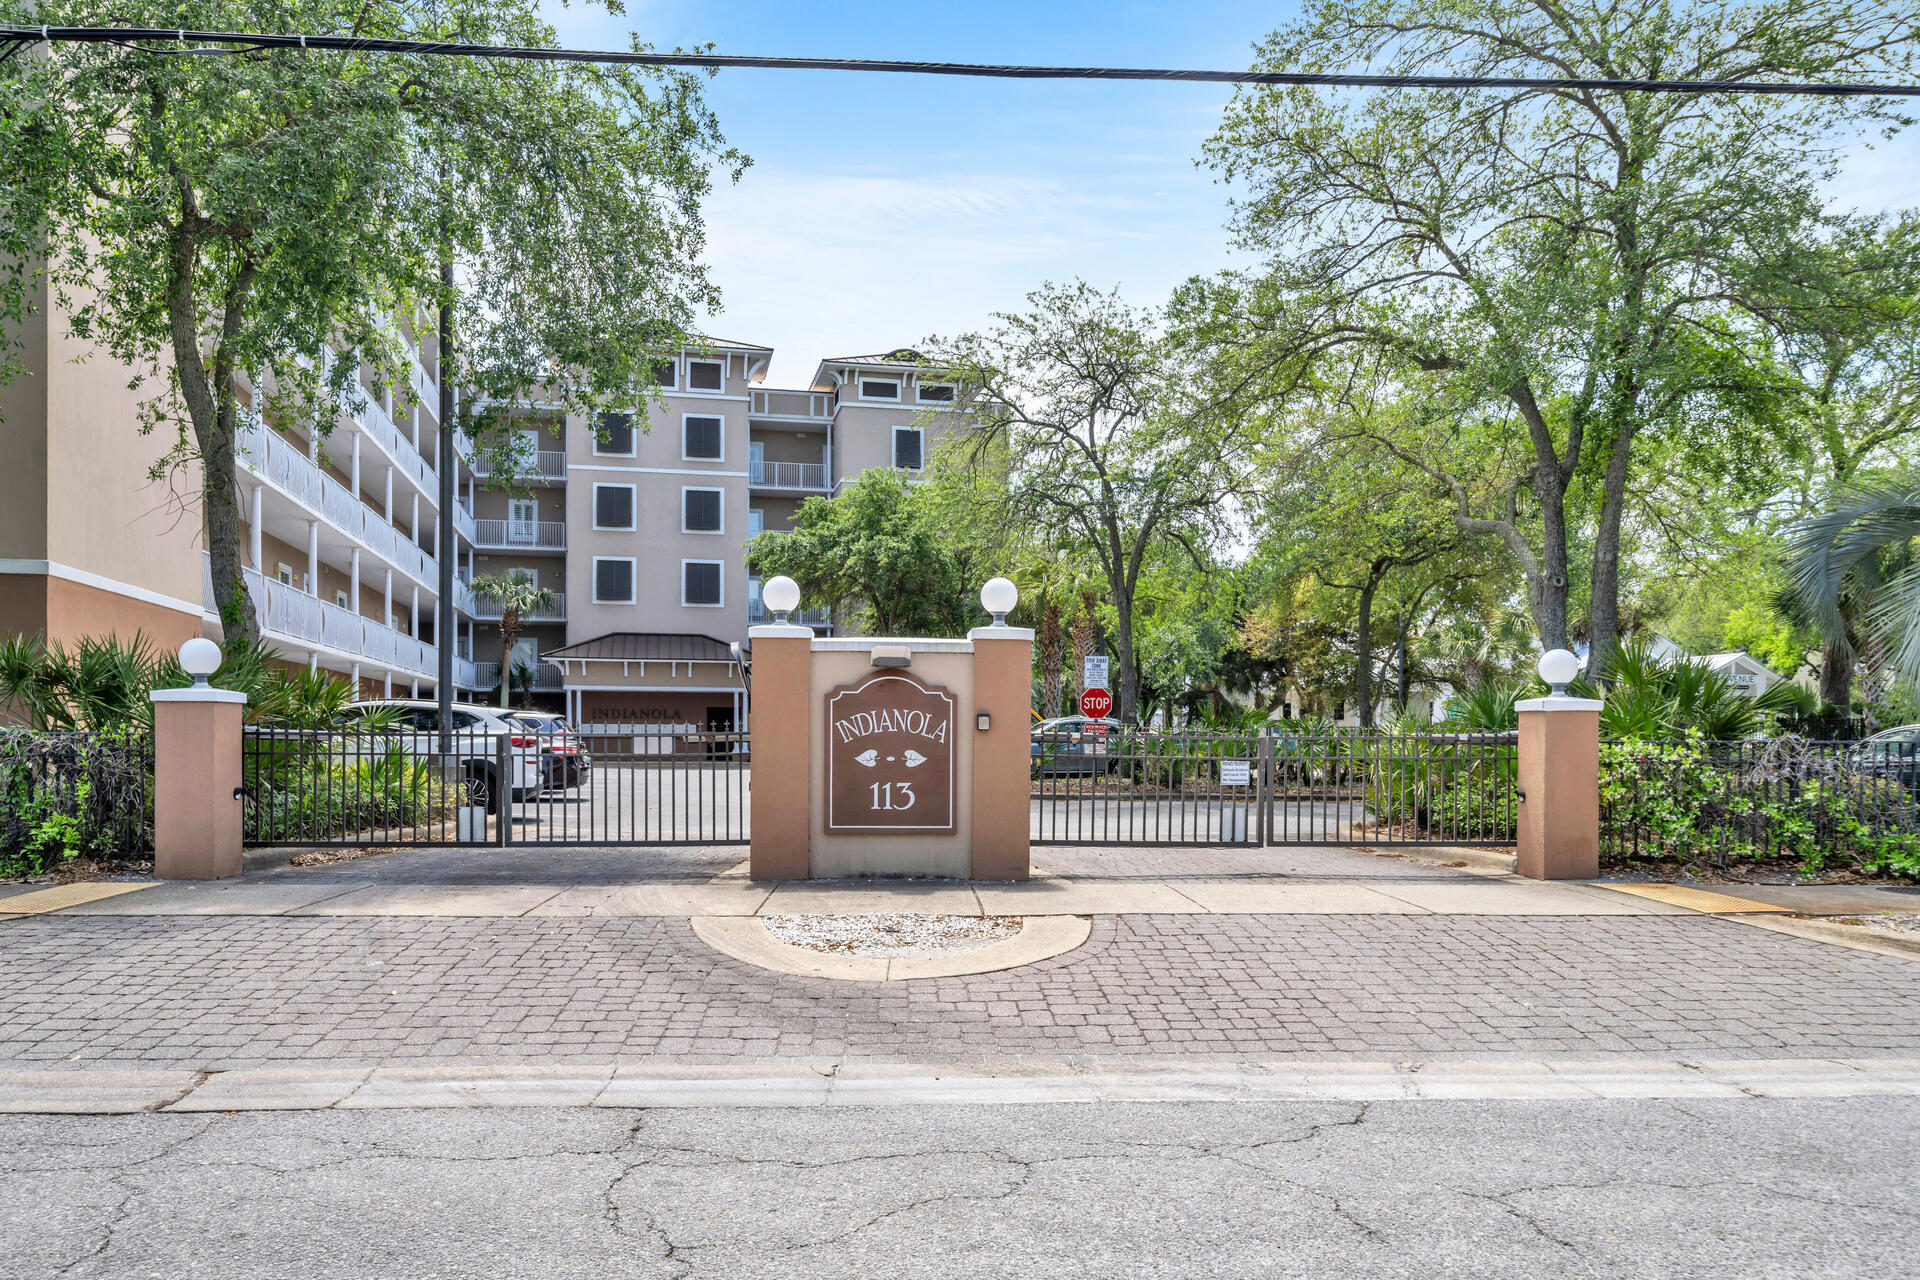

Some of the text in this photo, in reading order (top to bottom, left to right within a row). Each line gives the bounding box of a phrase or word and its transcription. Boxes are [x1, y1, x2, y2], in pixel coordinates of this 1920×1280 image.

[592, 708, 683, 720] INDIANOLA
[1083, 697, 1110, 710] STOP
[835, 709, 947, 743] INDIANOLA
[870, 782, 916, 811] 113
